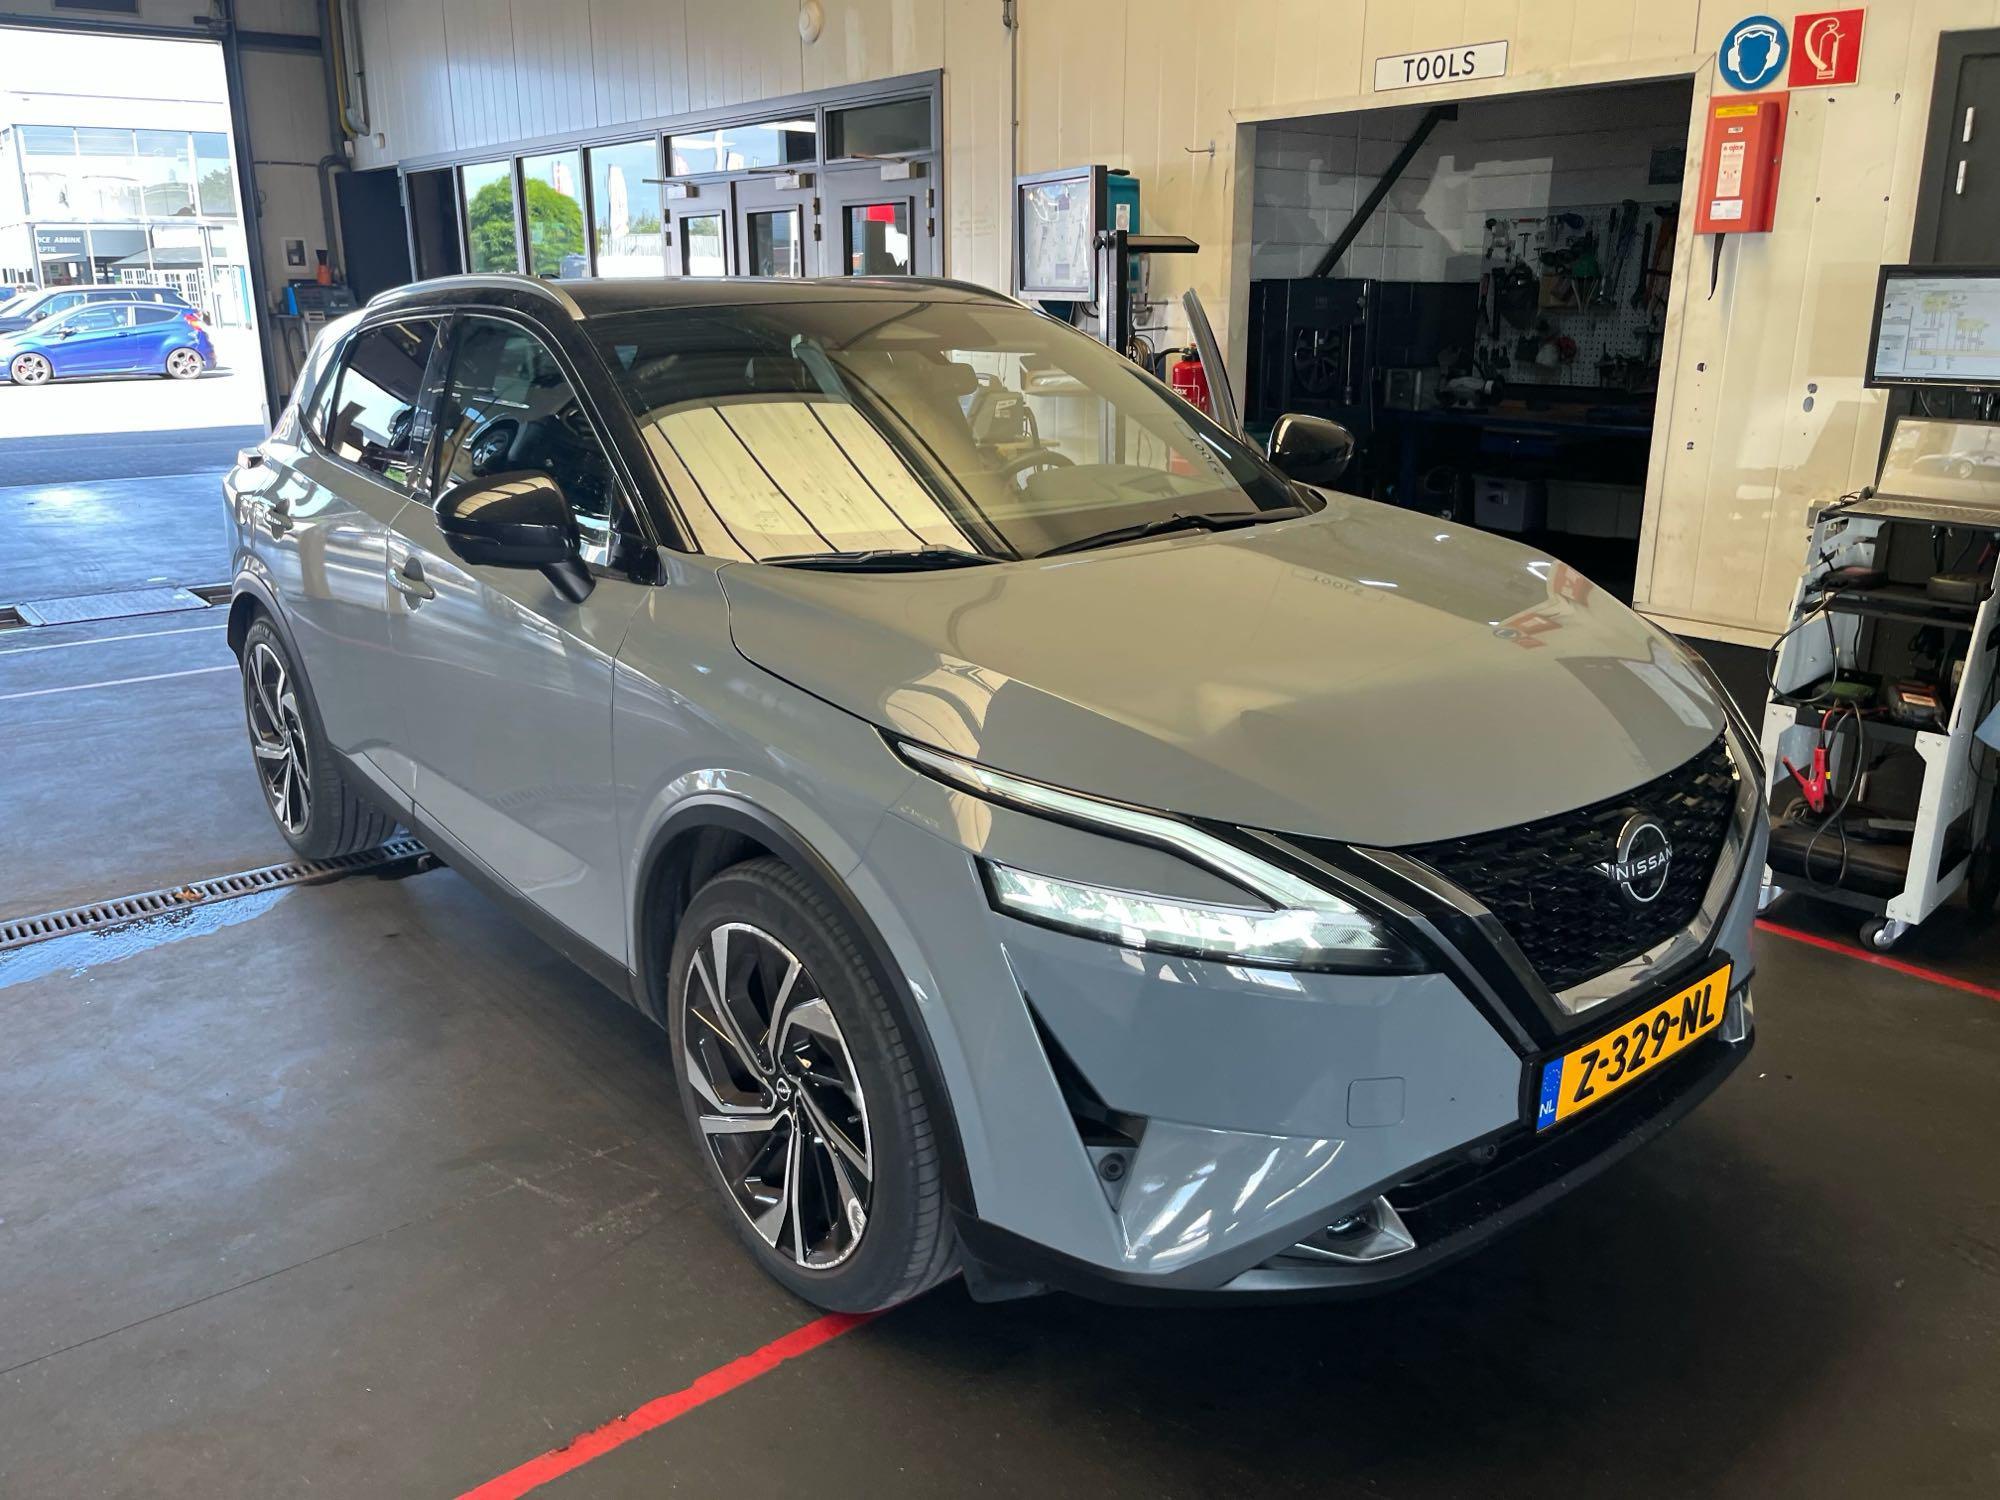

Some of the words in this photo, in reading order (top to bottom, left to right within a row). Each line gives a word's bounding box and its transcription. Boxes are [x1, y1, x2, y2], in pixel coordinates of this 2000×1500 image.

[1403, 50, 1475, 82] TOOLS
[1616, 844, 1673, 880] NISSAN
[1573, 984, 1715, 1102] Z-329-NL
[1539, 1099, 1555, 1117] NL
